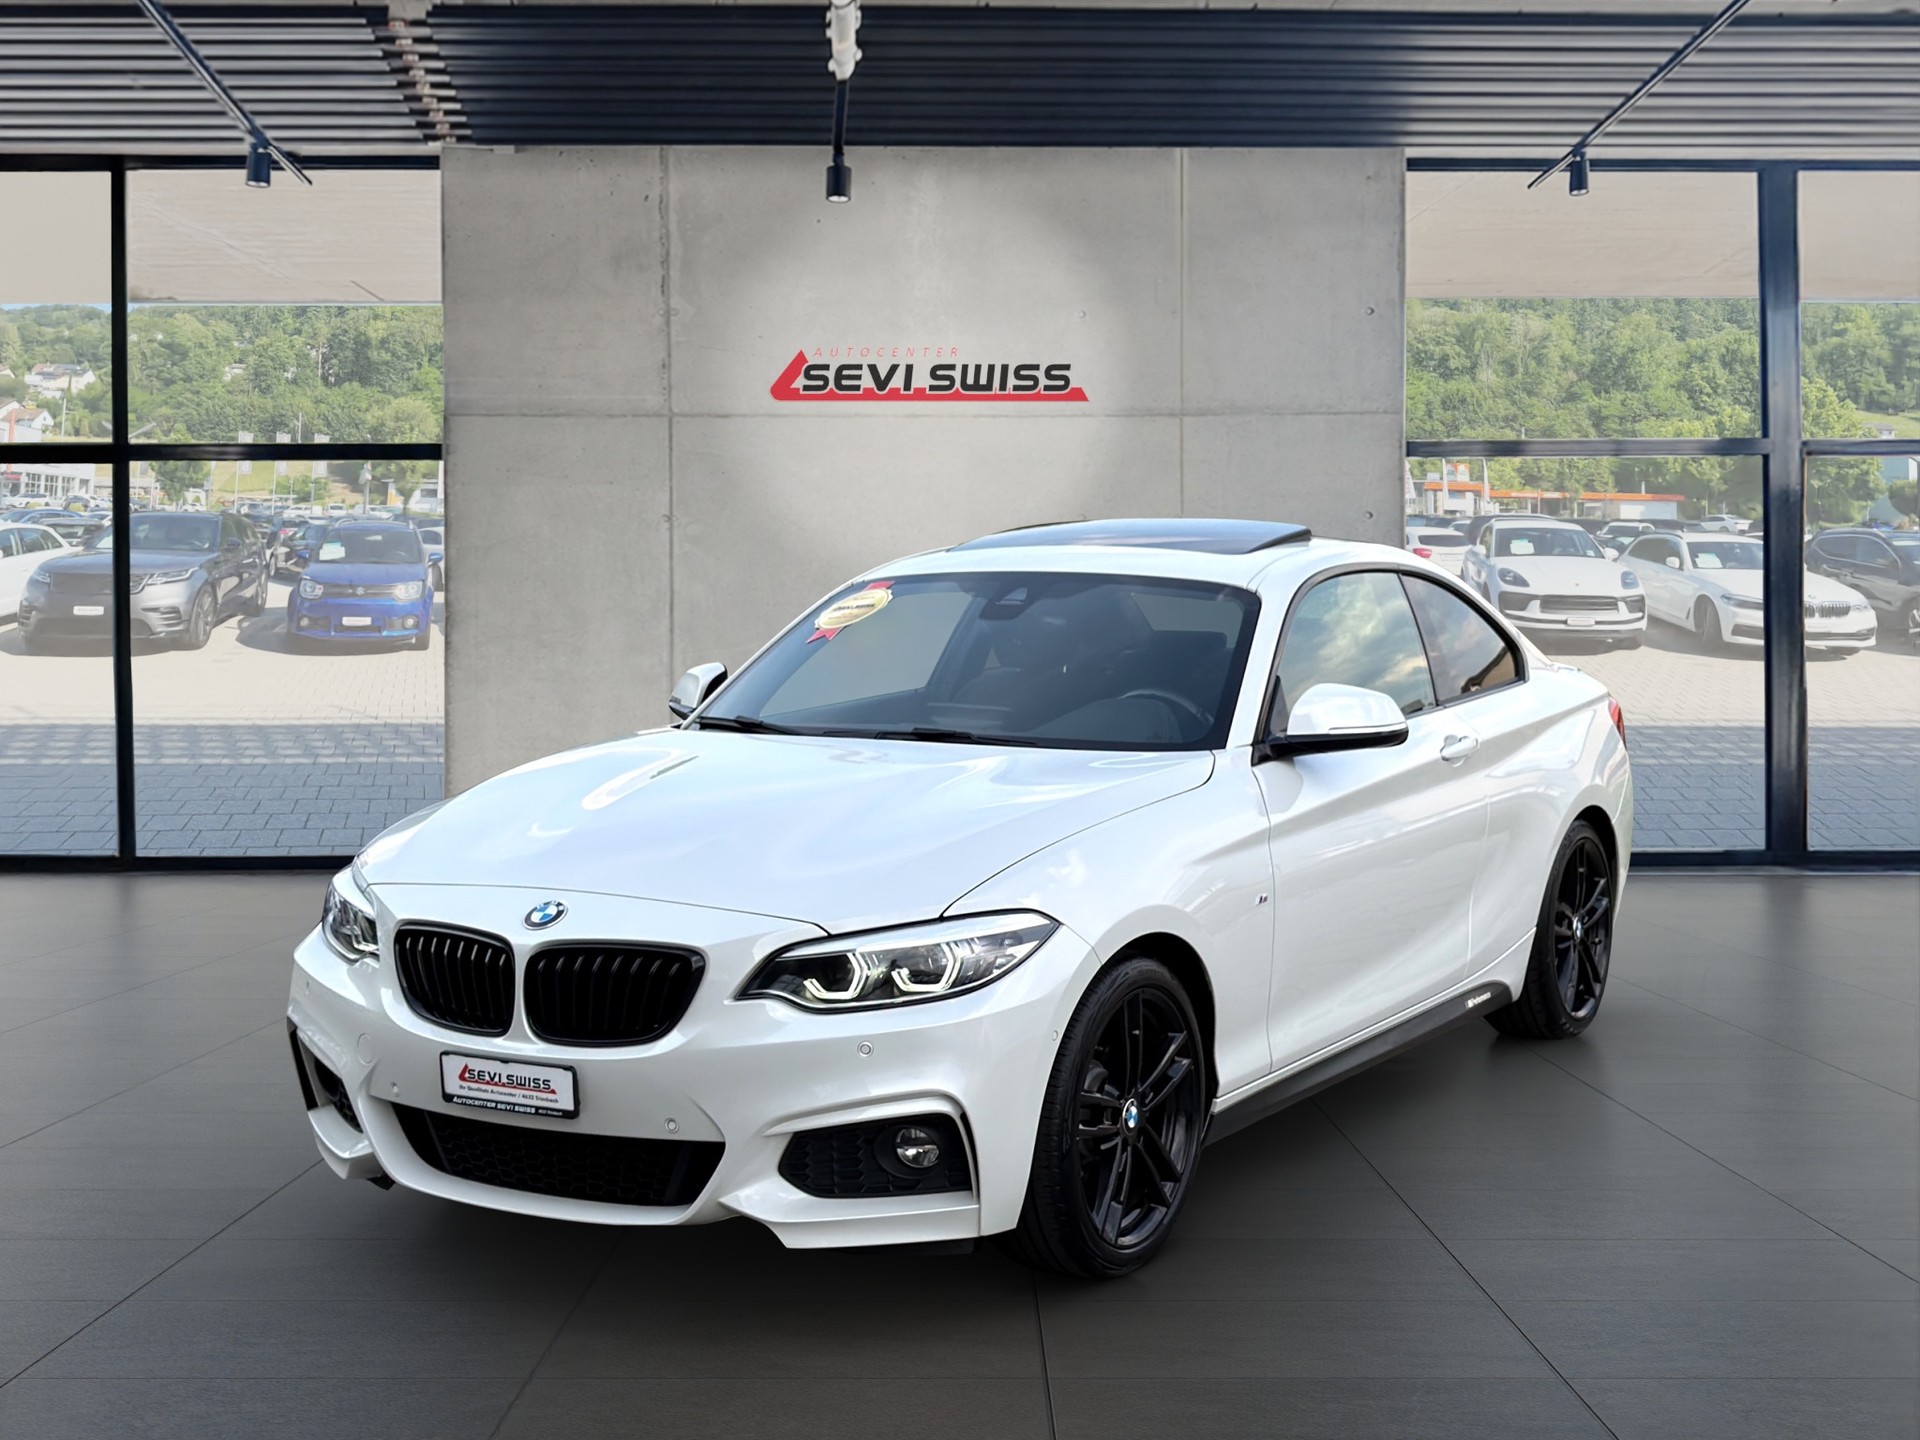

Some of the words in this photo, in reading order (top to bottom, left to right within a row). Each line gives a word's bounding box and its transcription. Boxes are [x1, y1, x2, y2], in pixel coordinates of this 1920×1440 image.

[813, 347, 960, 358] AUTOCENTER
[801, 363, 914, 392] SEVI
[928, 363, 1072, 392] SWISS
[467, 1069, 502, 1083] SEVI
[506, 1074, 551, 1090] SWISS
[497, 1103, 513, 1111] SEVI
[514, 1106, 536, 1114] SWISS
